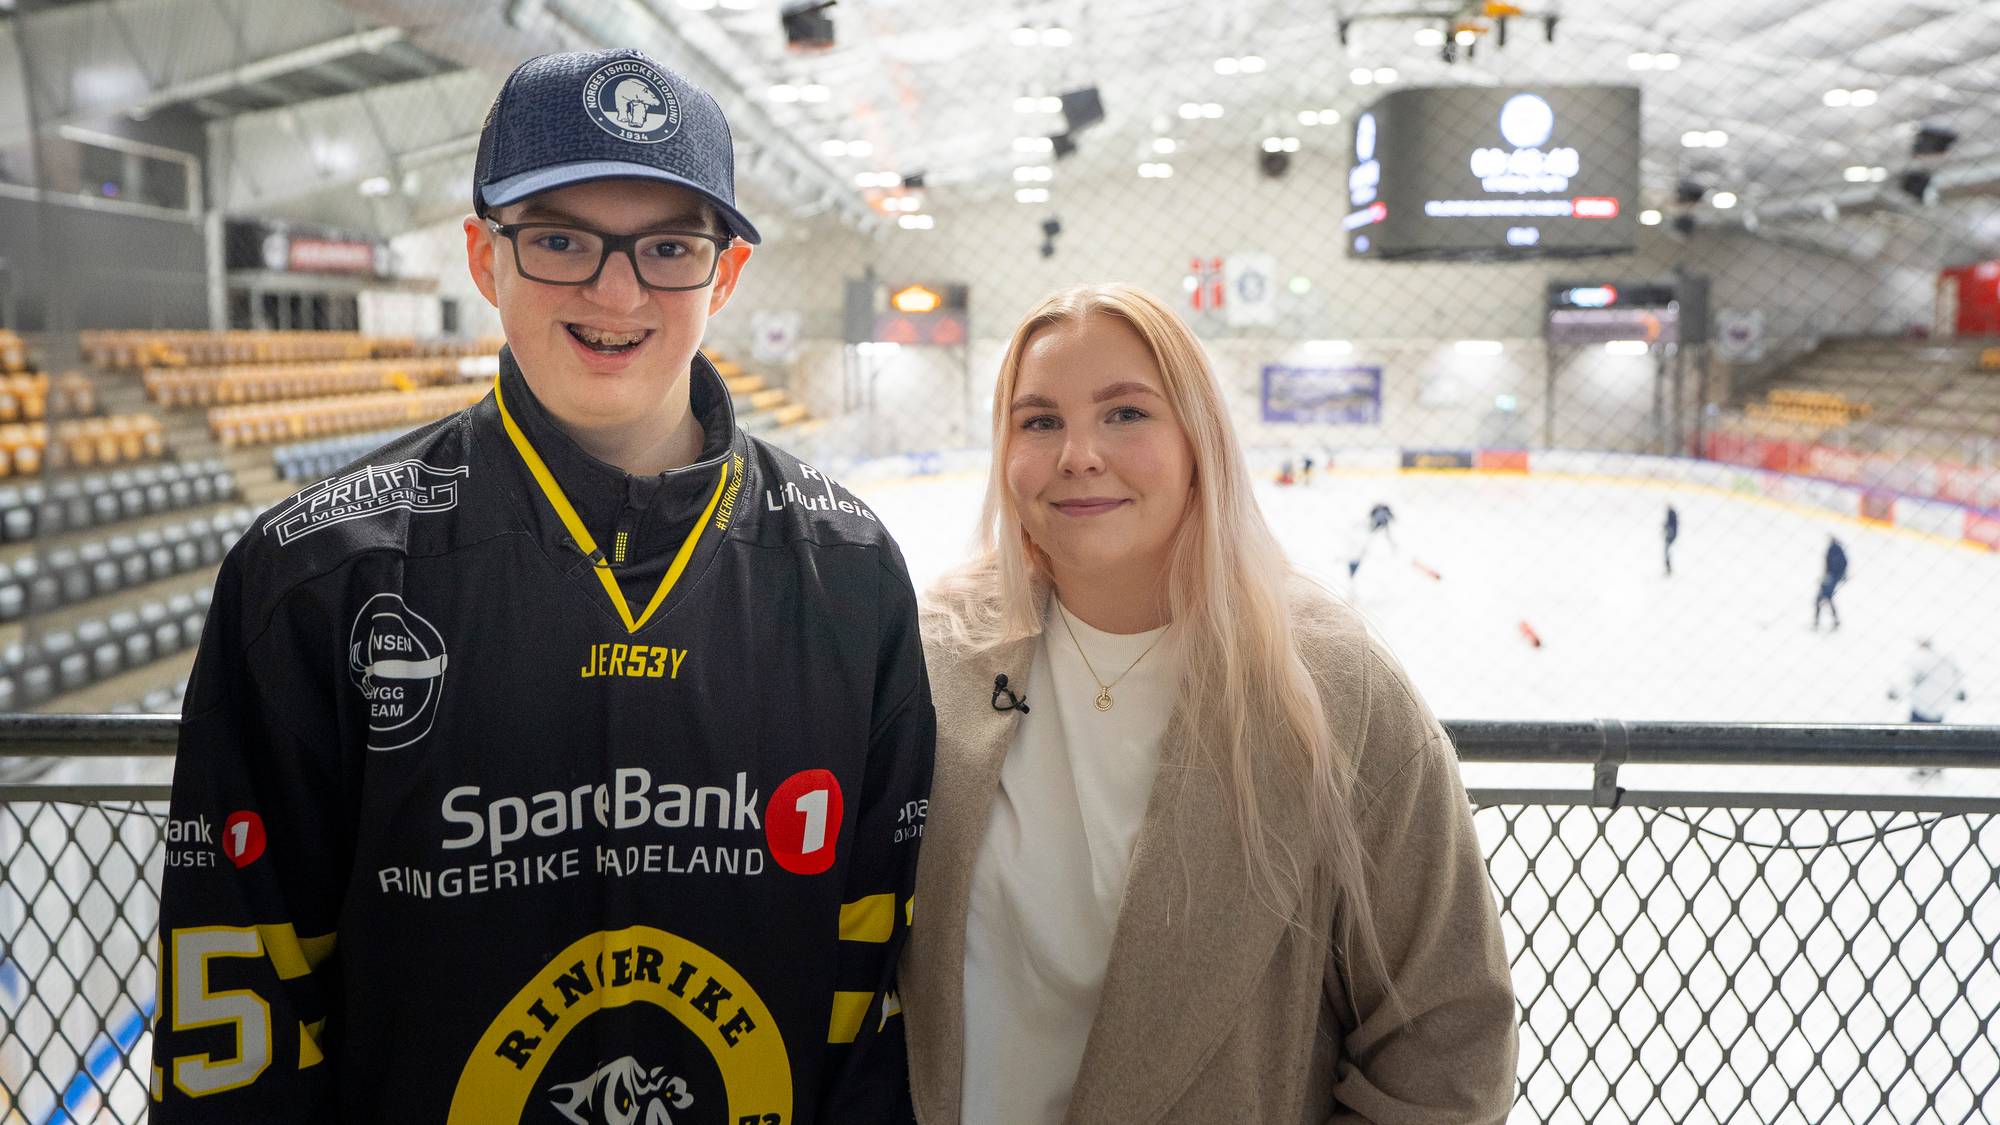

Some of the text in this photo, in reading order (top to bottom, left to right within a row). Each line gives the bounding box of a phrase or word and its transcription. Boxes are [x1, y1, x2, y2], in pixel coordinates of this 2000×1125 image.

[586, 63, 679, 124] NORGES ISHOCKEYFORBUND
[619, 129, 649, 141] 1934
[580, 643, 689, 680] JER53Y
[440, 767, 829, 857] SpareBank 1
[230, 820, 250, 858] 1
[377, 848, 580, 899] RINGERIKE
[151, 924, 273, 1102] 5
